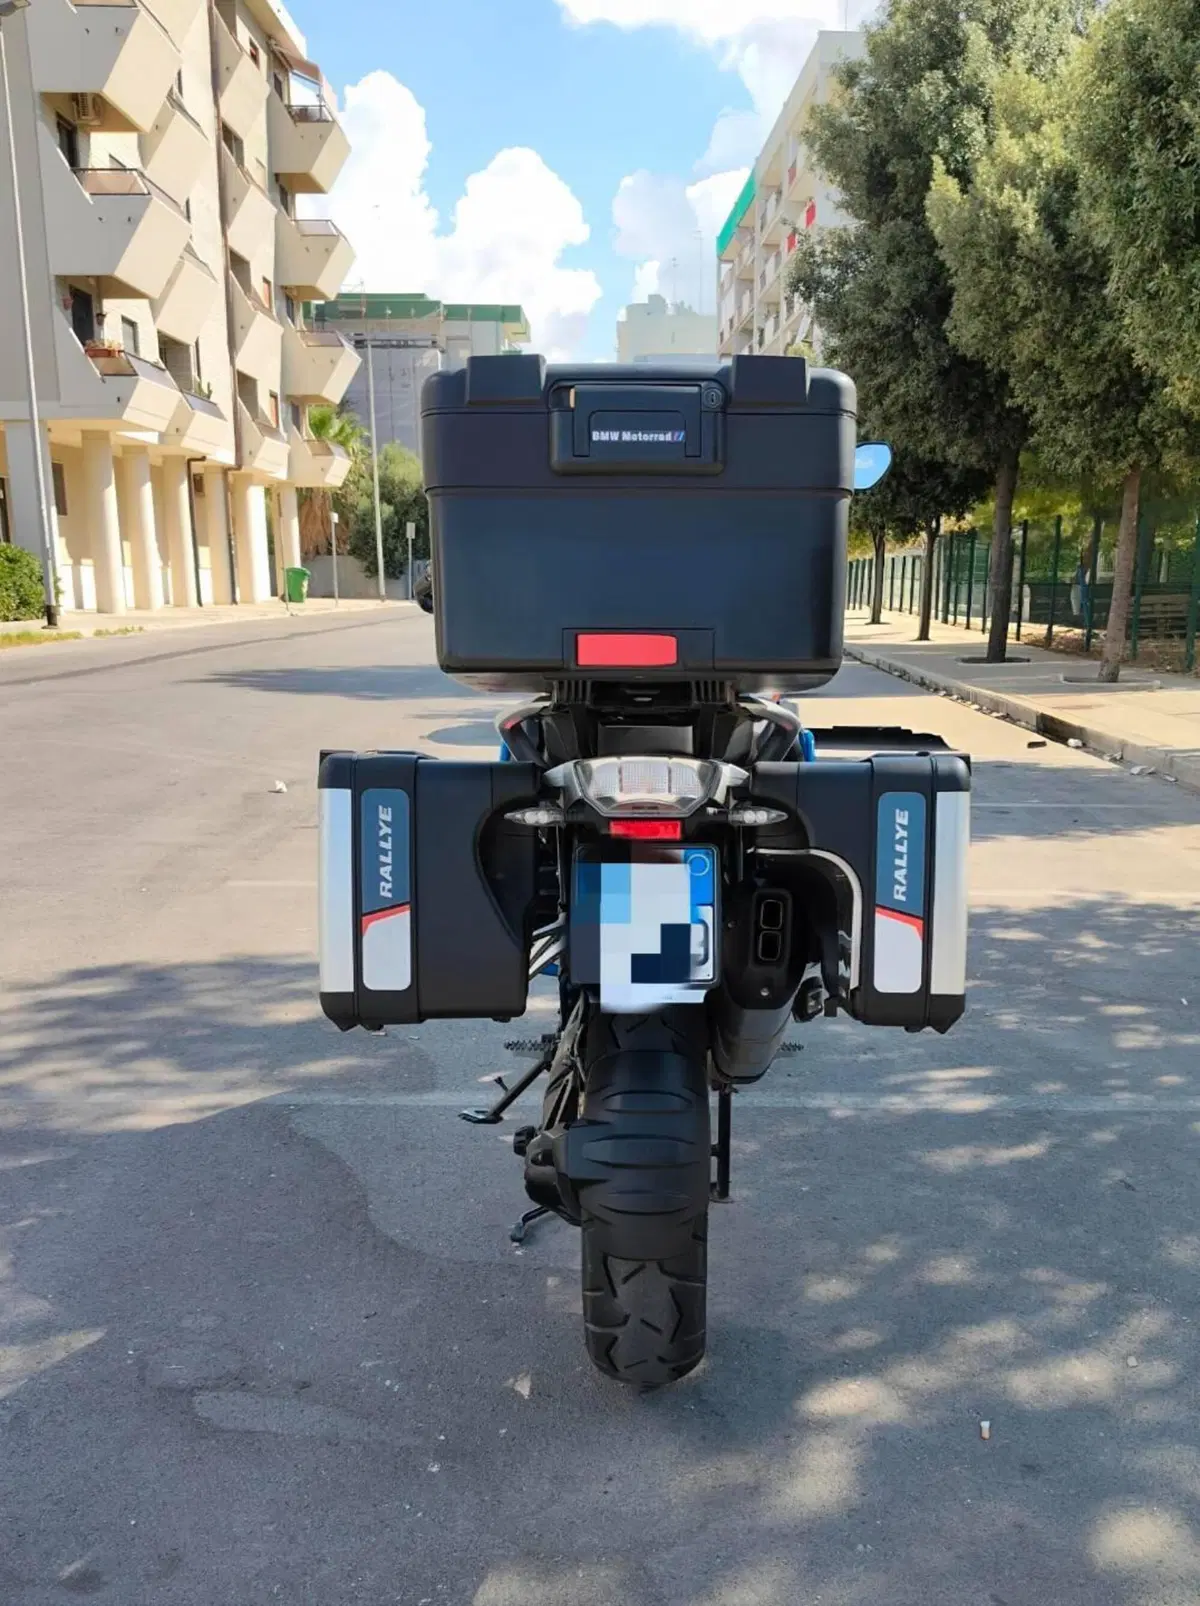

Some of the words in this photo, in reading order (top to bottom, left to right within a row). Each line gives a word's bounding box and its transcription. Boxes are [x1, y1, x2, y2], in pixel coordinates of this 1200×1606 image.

[592, 431, 620, 441] BMW
[622, 431, 672, 441] Motorrad
[376, 805, 393, 898] RALLYE
[893, 808, 909, 902] RALLYE
